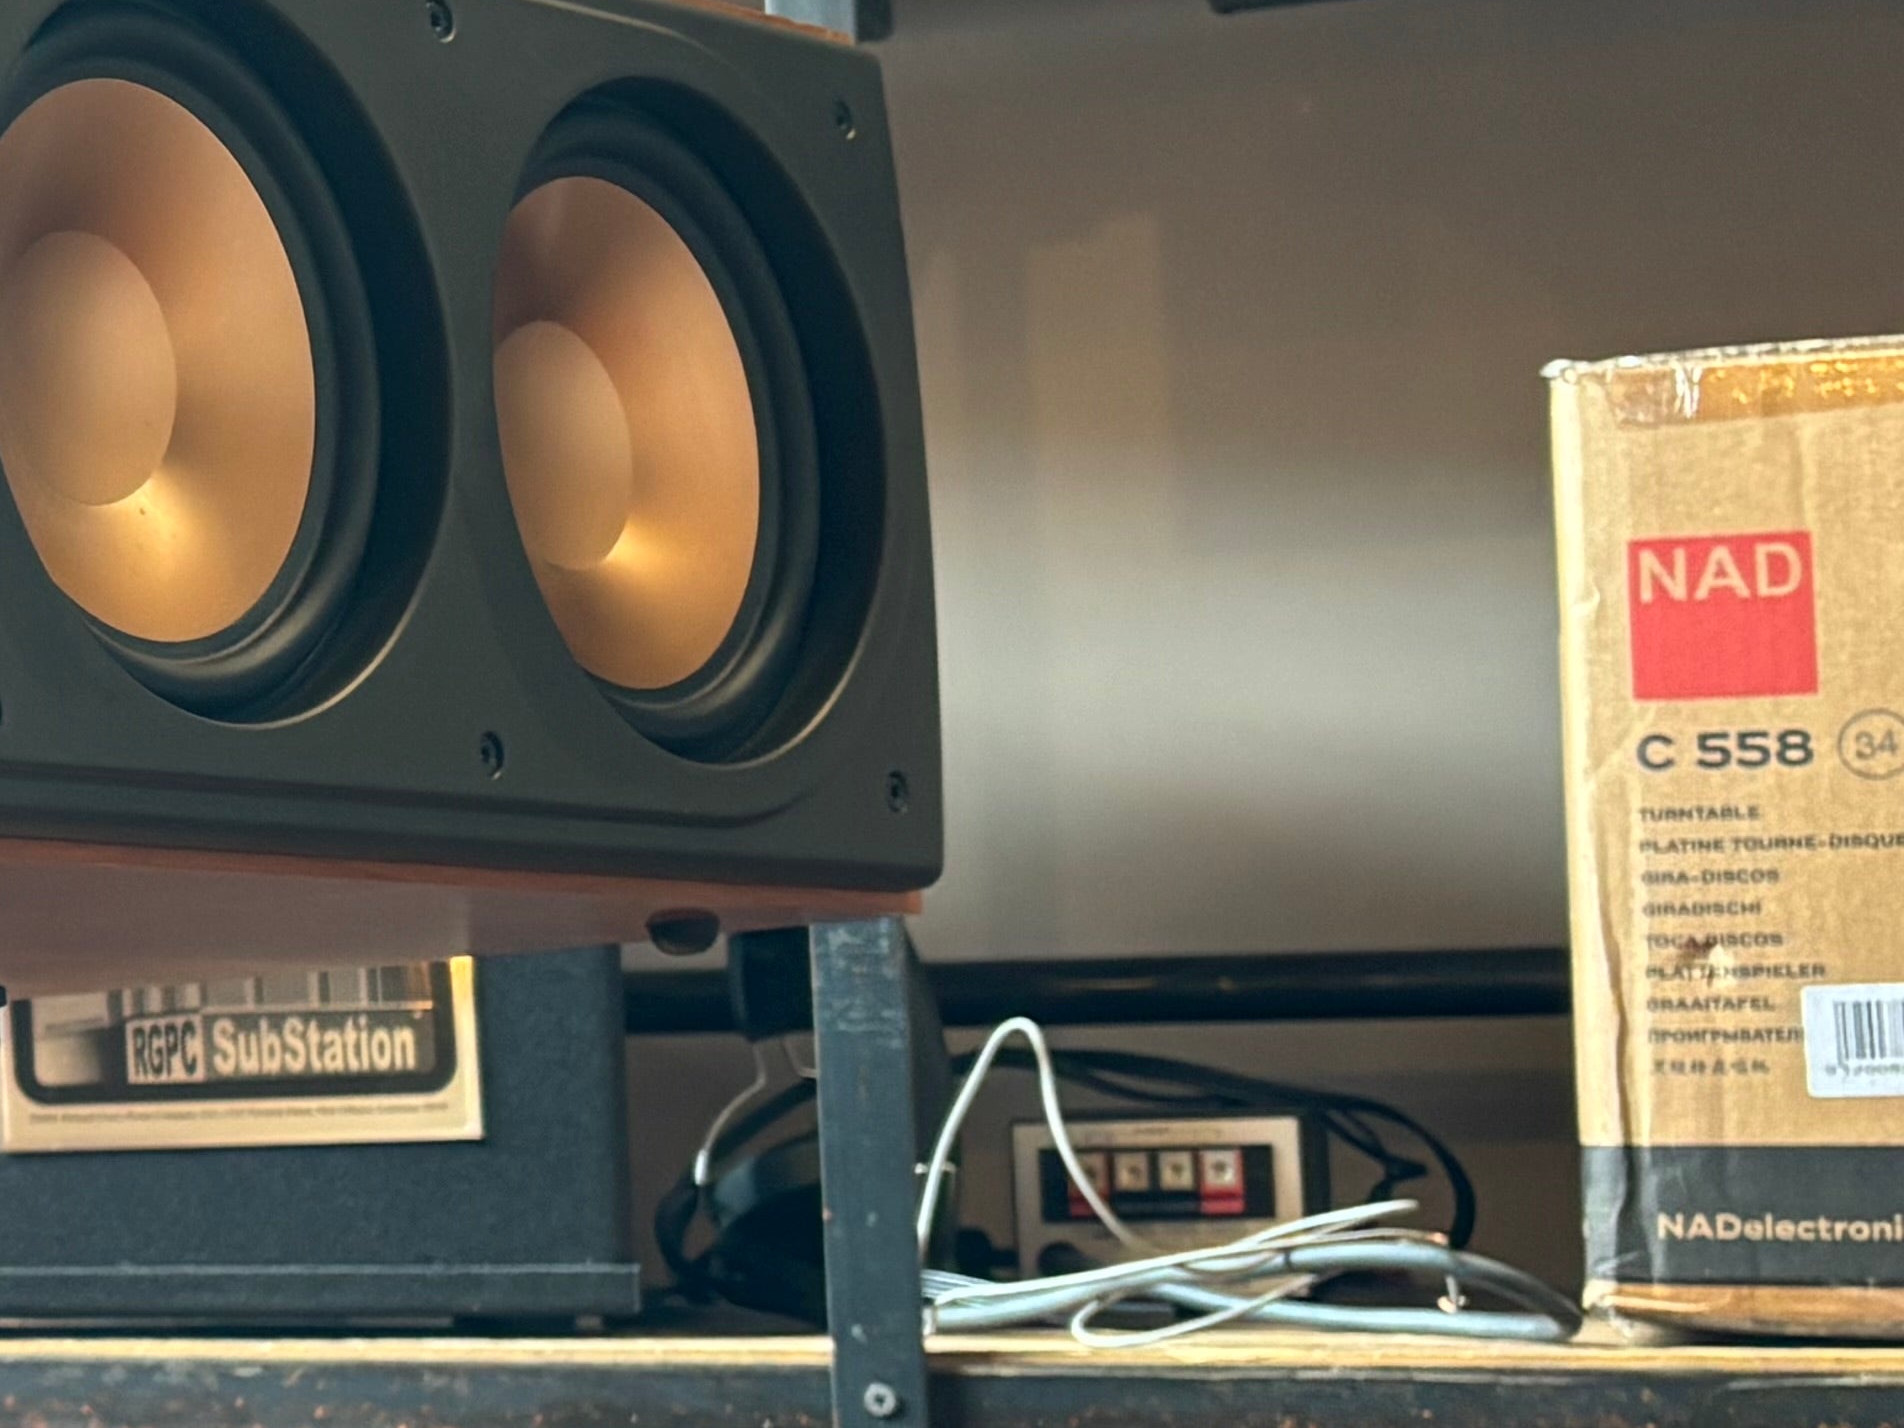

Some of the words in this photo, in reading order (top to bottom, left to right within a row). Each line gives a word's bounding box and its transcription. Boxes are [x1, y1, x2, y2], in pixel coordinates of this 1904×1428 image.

[1638, 541, 1803, 604] NAD
[1636, 733, 1676, 771] C
[1695, 728, 1815, 770] 558
[1855, 729, 1899, 761] 34
[1640, 804, 1761, 822] TURNTABLE
[1639, 836, 1724, 854] PLATINE
[1641, 867, 1780, 886] GIRA-DISCOS
[1642, 900, 1762, 917] GIRADISCHI
[132, 1020, 198, 1078] RGPC
[212, 1014, 417, 1073] SubStation
